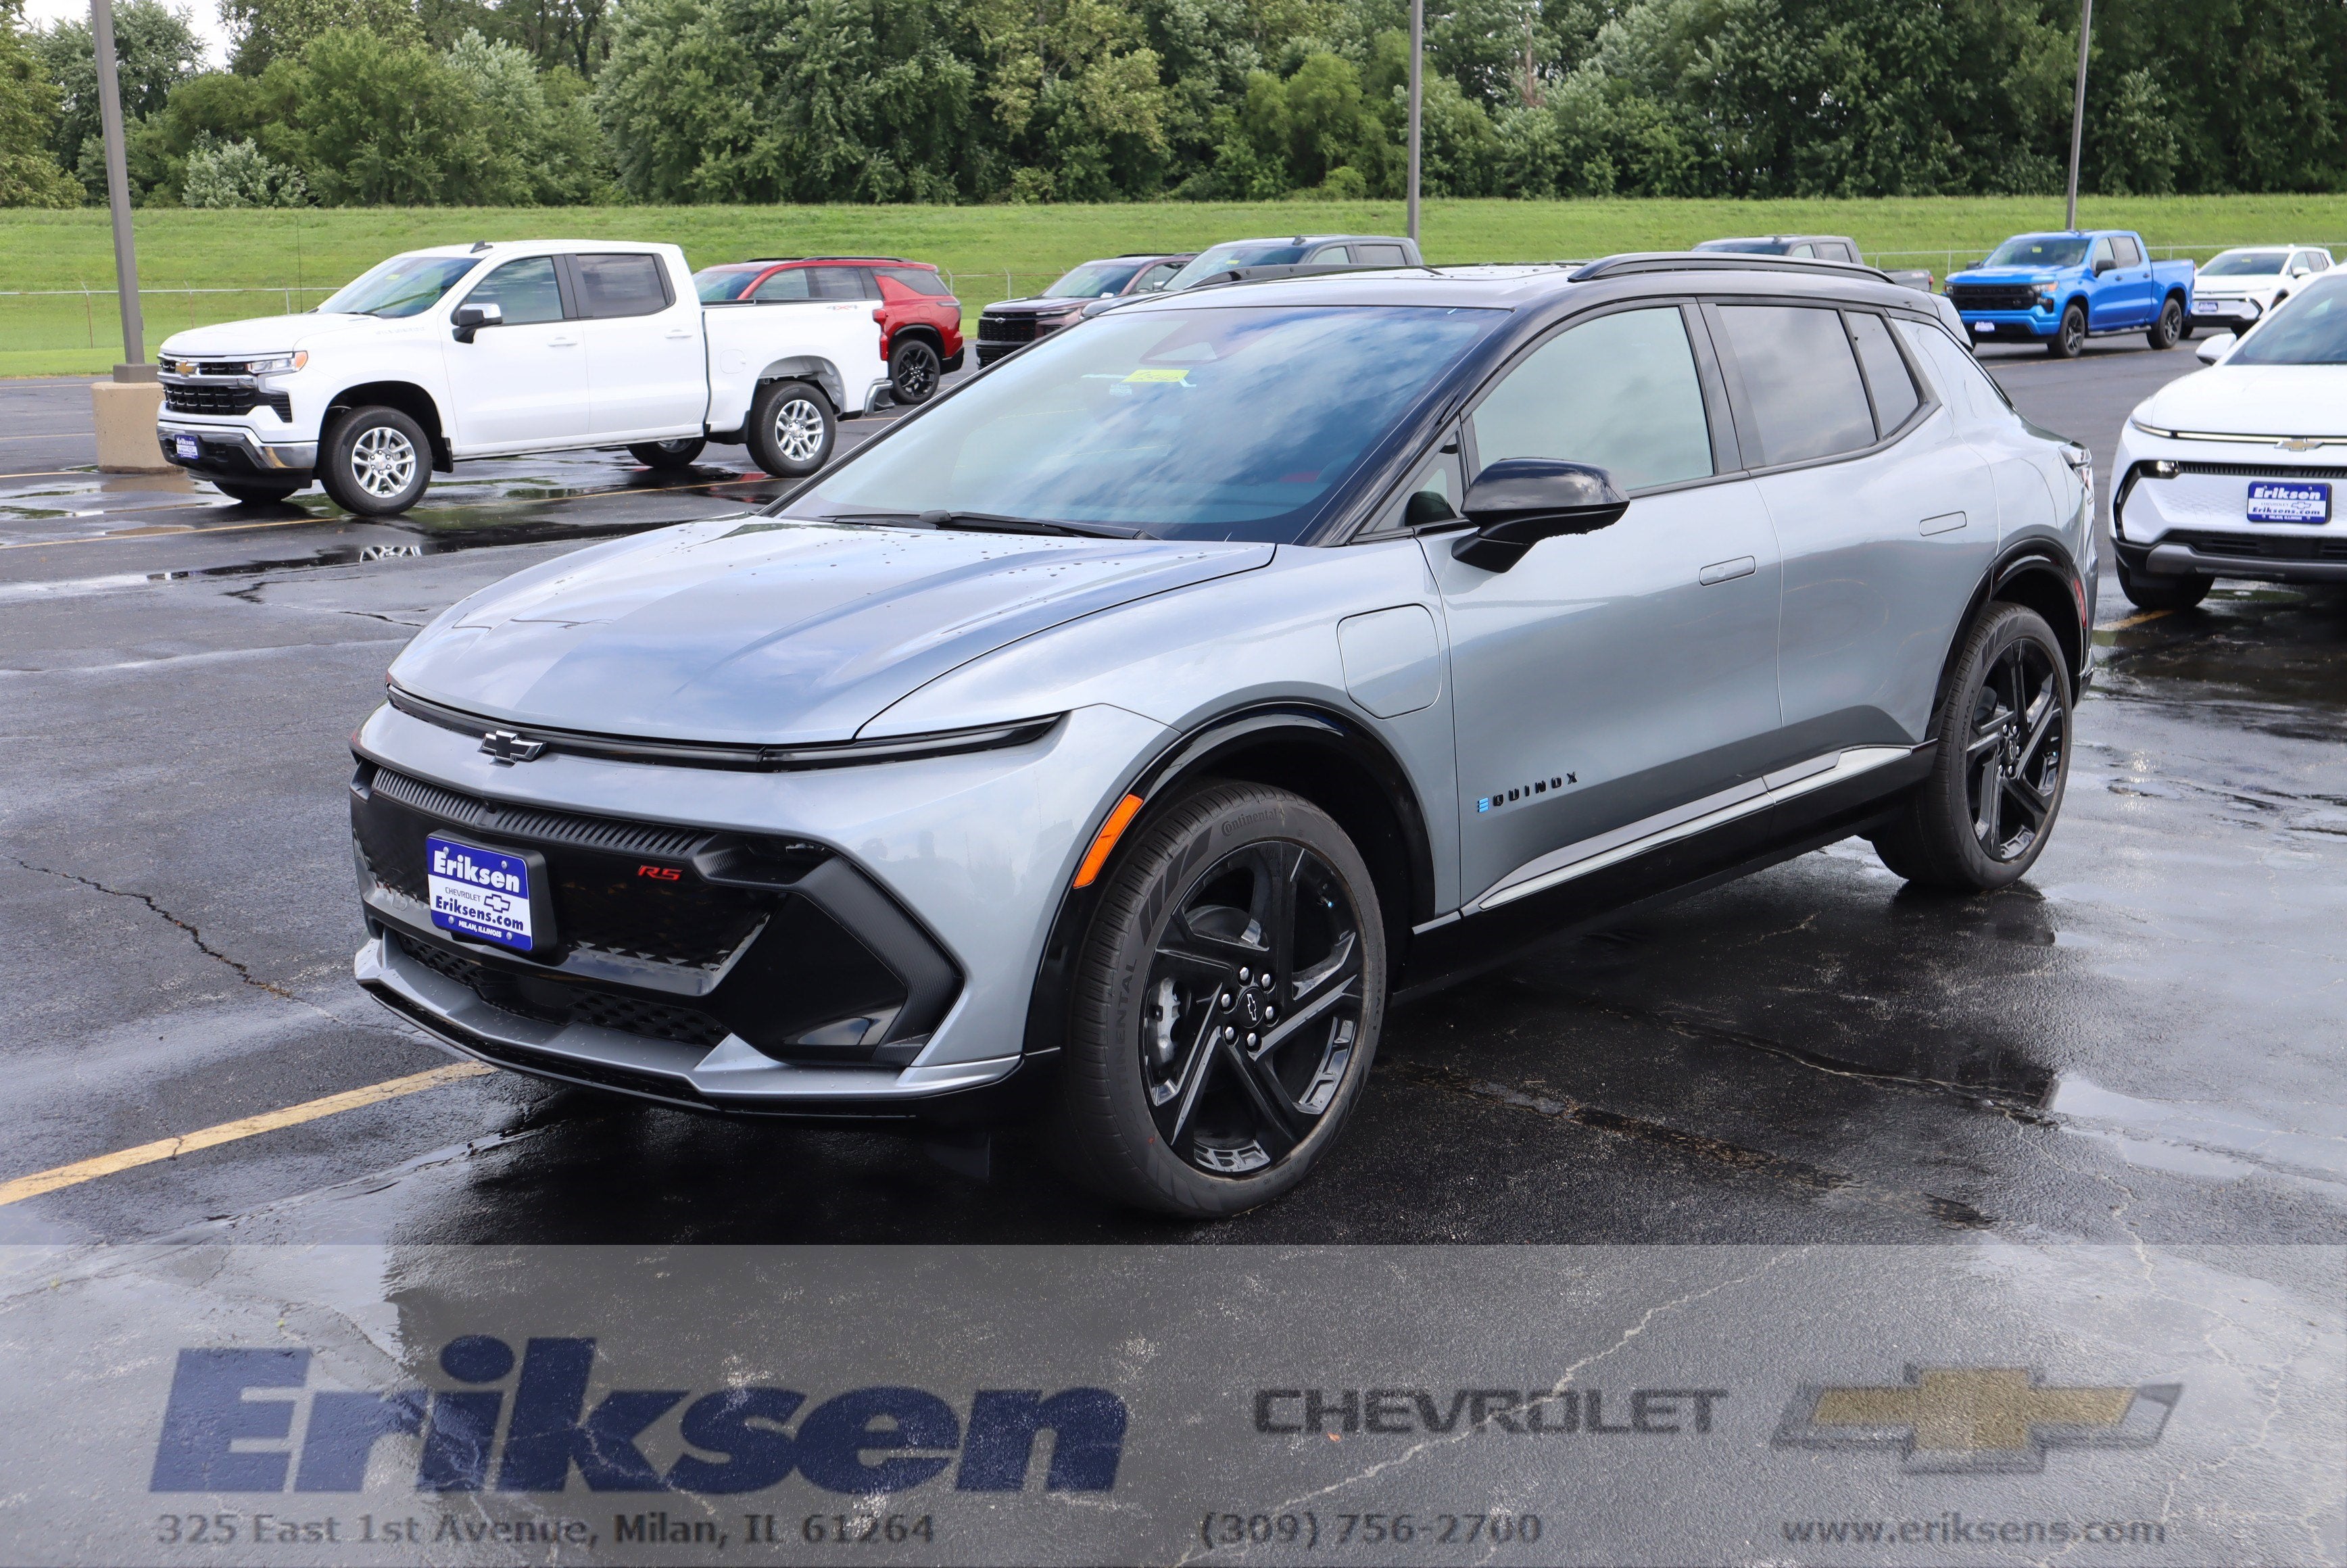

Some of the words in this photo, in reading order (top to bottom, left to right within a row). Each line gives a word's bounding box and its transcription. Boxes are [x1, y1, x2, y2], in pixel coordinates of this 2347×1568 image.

[433, 850, 520, 893] Eriksen
[637, 865, 683, 881] RS
[445, 887, 481, 902] CHEVROLET
[435, 896, 523, 931] Eriksens.com
[458, 920, 477, 933] MILAN,
[478, 925, 502, 938] ILLINOIS
